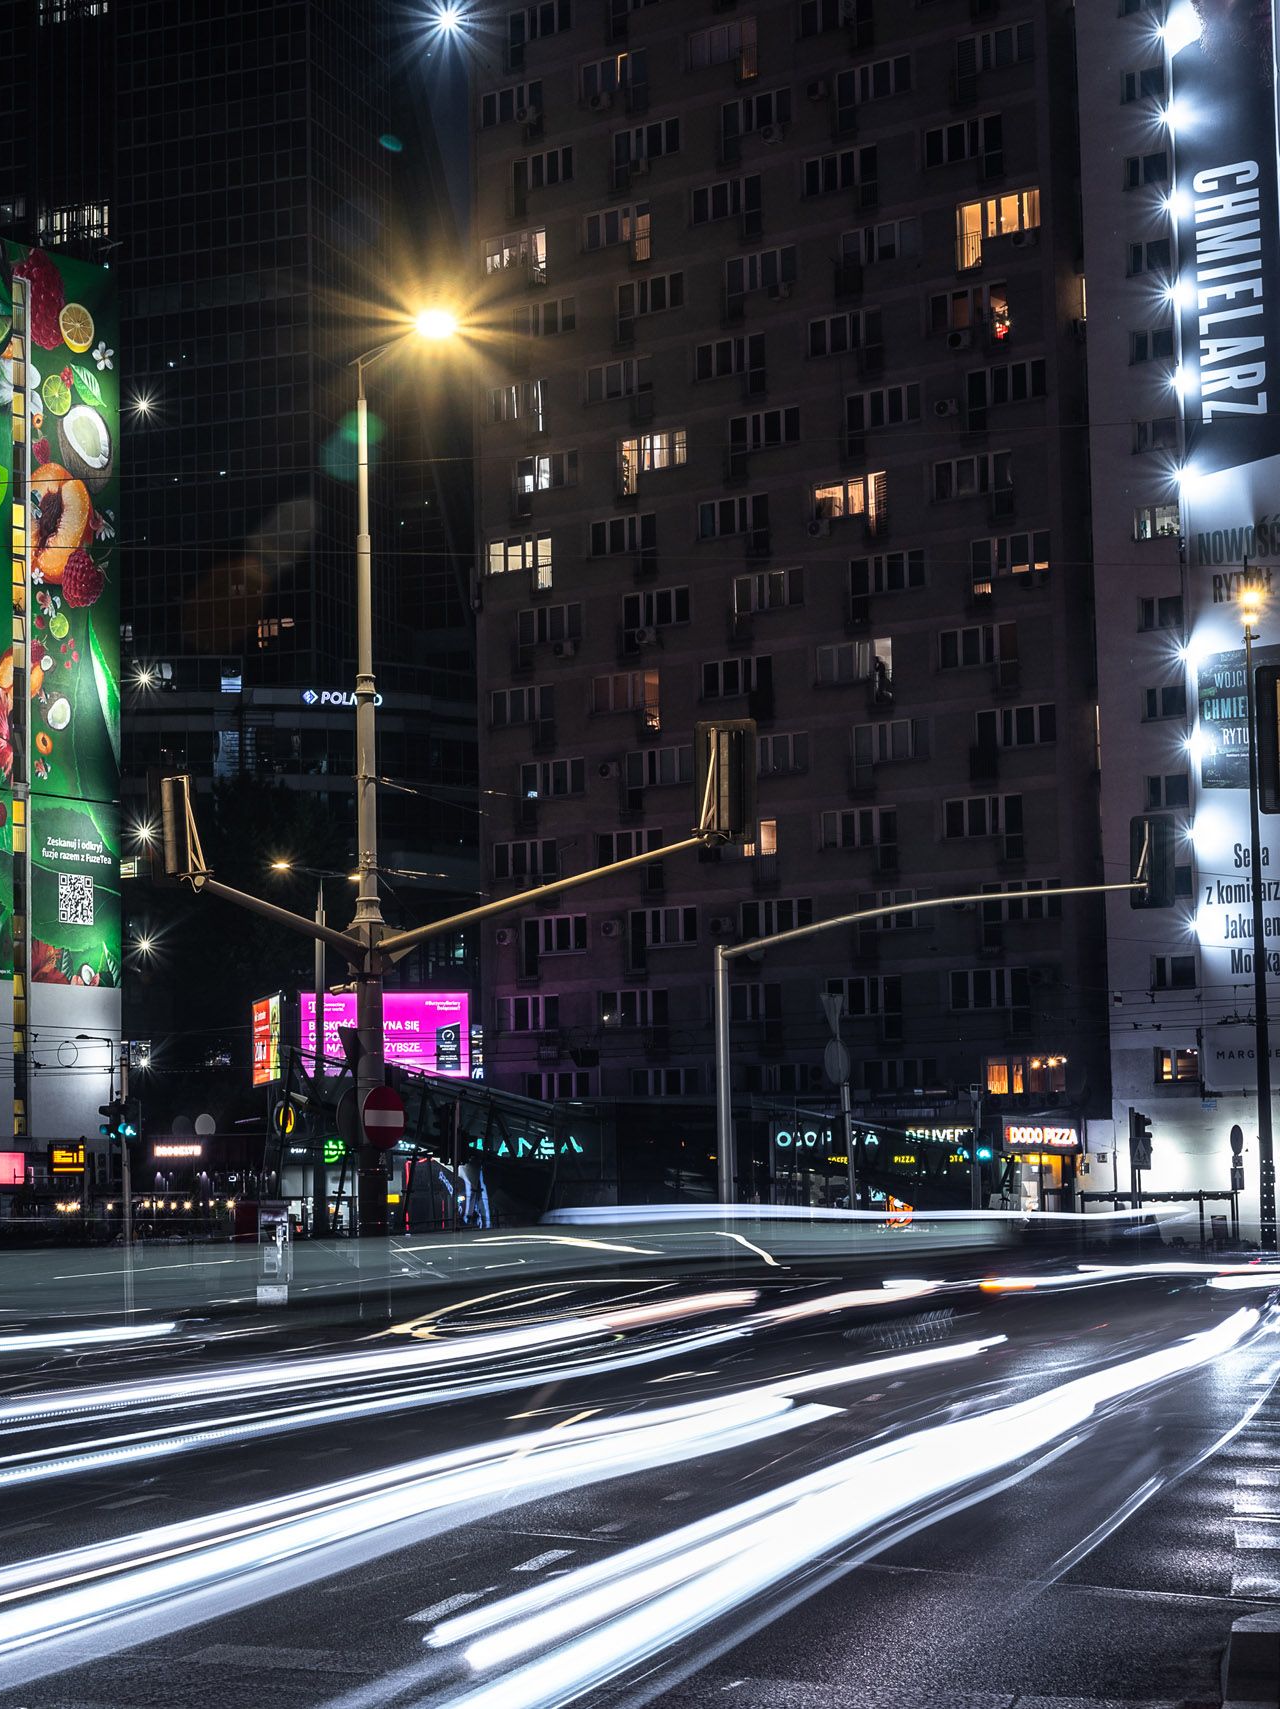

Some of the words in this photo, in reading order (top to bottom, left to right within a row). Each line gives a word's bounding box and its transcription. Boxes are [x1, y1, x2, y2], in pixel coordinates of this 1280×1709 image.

[1193, 160, 1268, 425] CHMIELARZ
[320, 691, 383, 707] POLAD
[46, 836, 77, 850] Zeskanuj
[81, 840, 103, 854] odkryj
[60, 851, 80, 862] razem
[86, 854, 112, 865] FuzeTea
[1233, 843, 1270, 868] Sea
[1206, 886, 1213, 905] z
[308, 1019, 355, 1031] BSKOŚĆ
[1010, 1126, 1043, 1145] DODO
[1043, 1127, 1078, 1146] PIZZA
[893, 1155, 915, 1164] PIZZA
